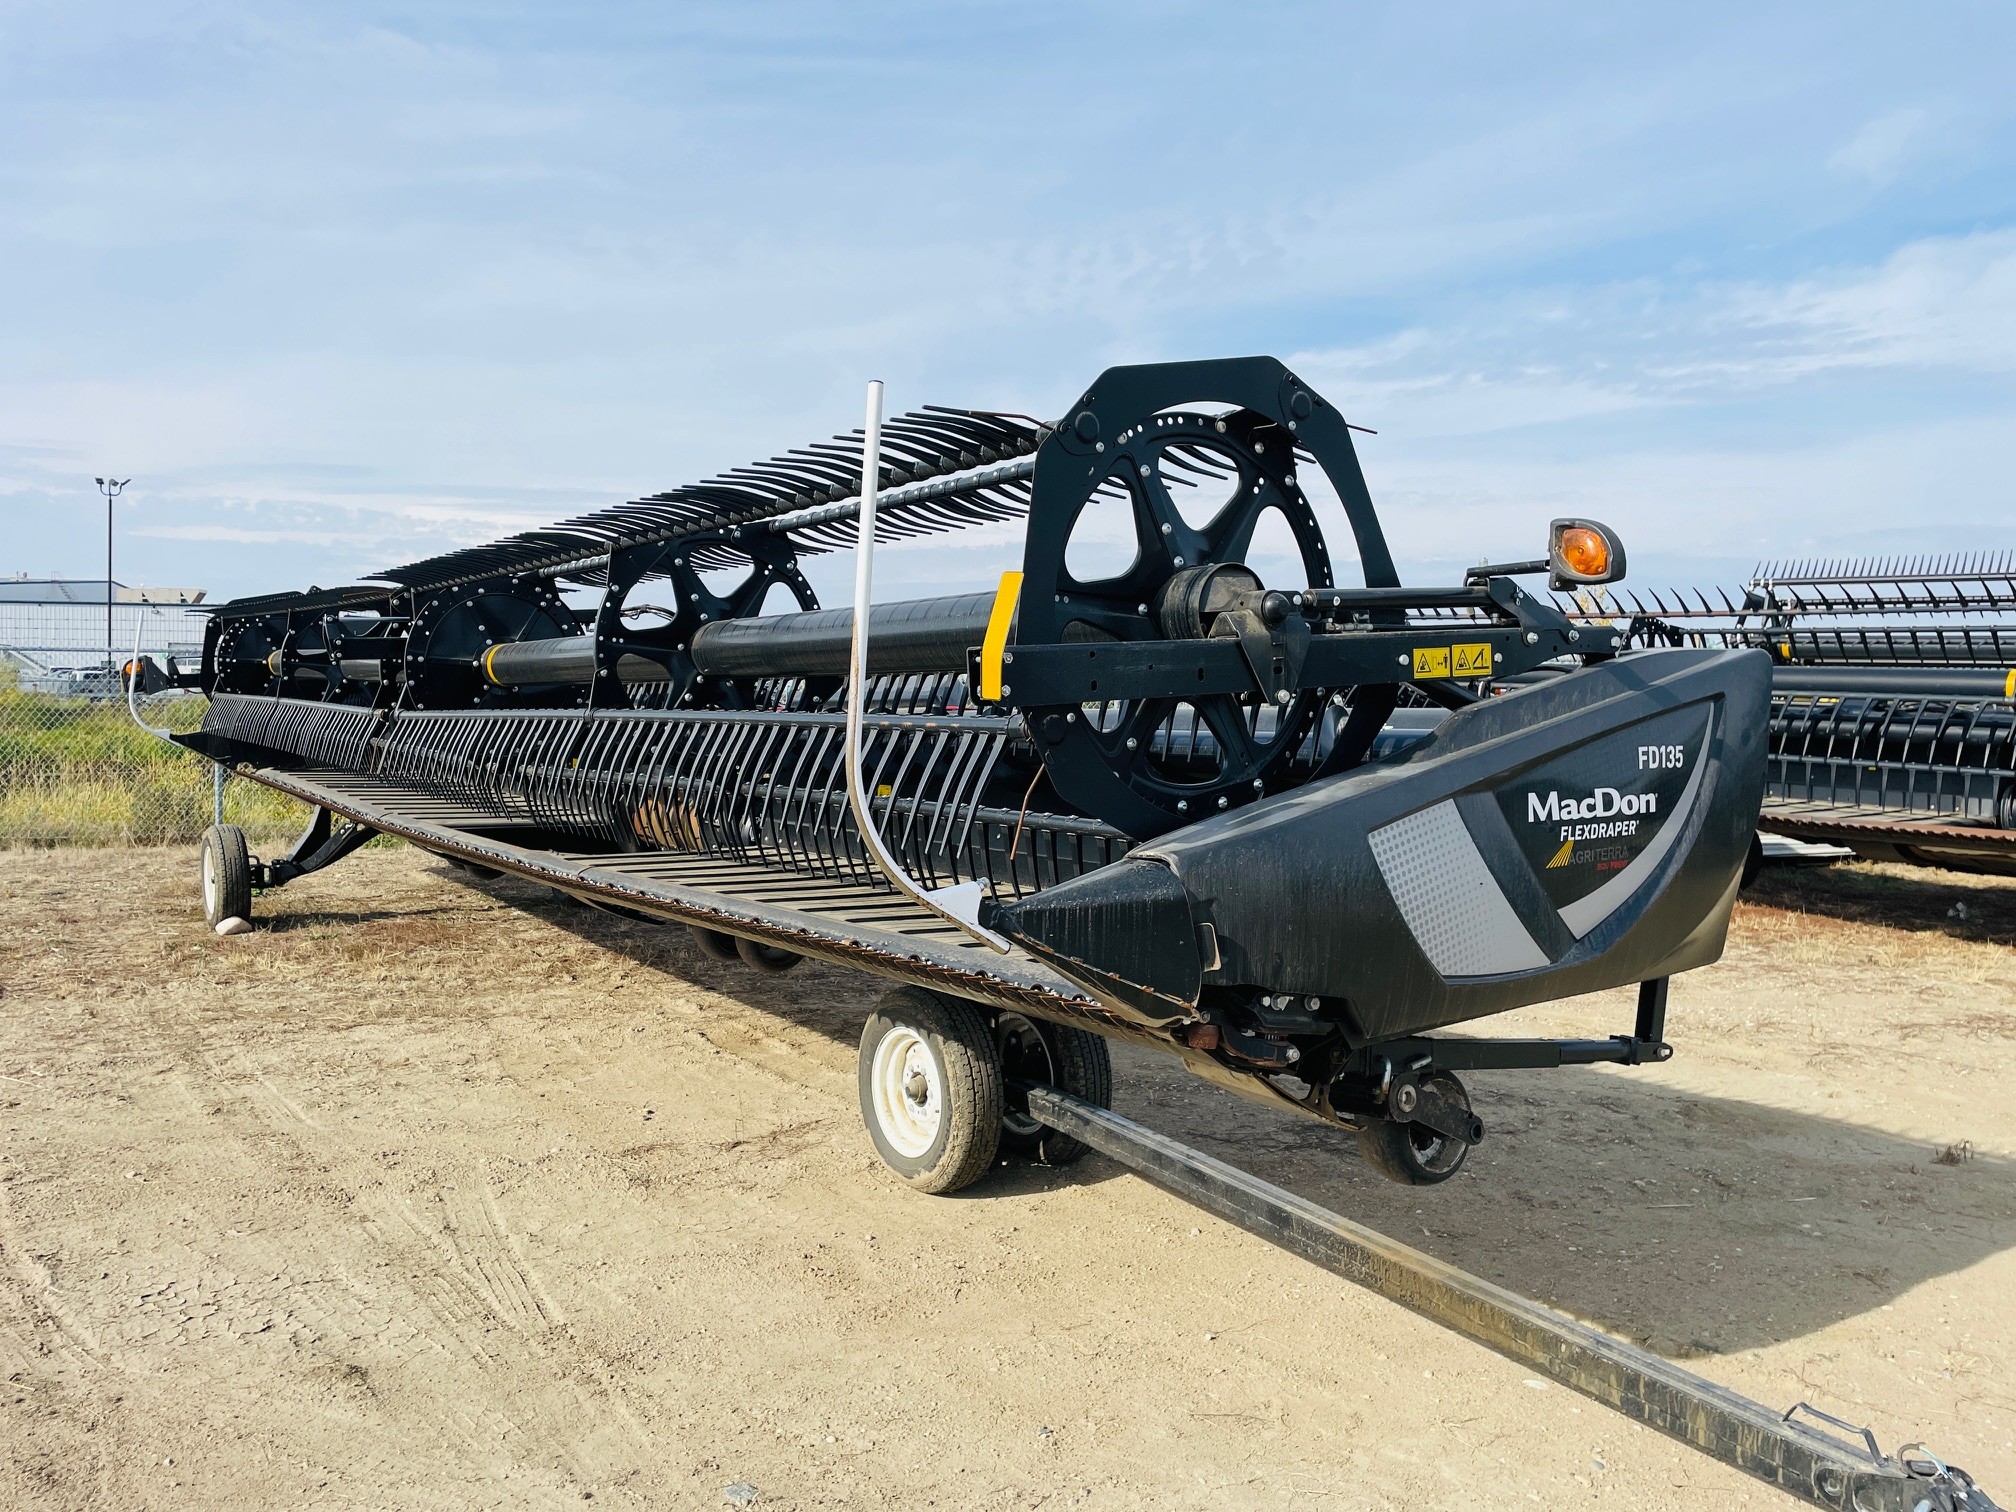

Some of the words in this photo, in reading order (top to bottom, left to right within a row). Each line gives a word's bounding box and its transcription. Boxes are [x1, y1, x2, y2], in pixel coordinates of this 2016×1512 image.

[1638, 745, 1684, 770] FD135
[1527, 787, 1657, 823] MacDon
[1560, 820, 1637, 842] FLEXDRAPER
[1568, 845, 1629, 866] AGRITERRA
